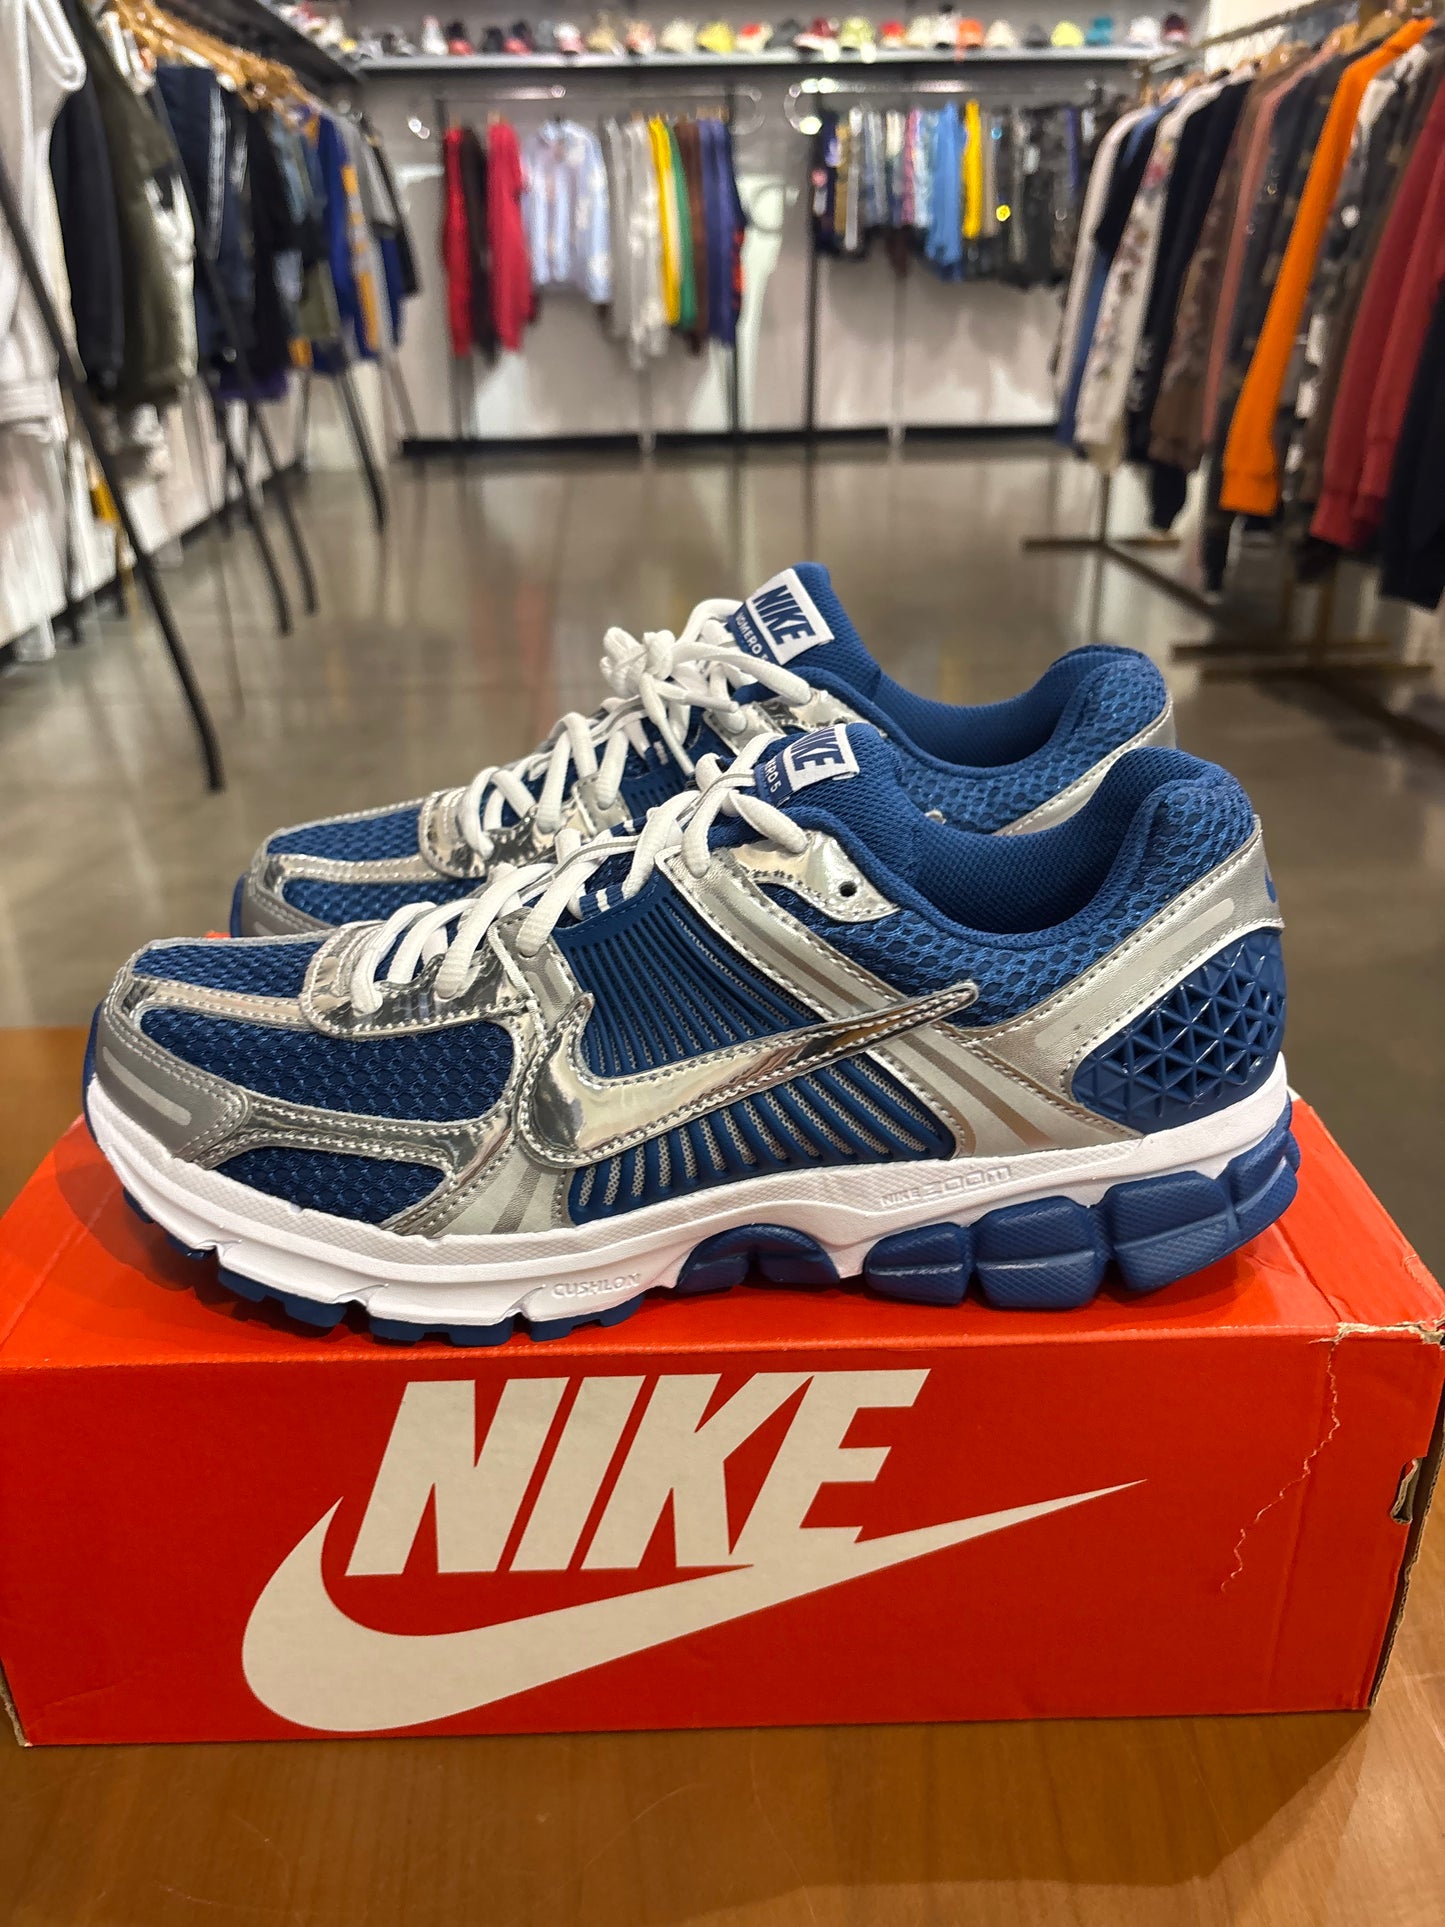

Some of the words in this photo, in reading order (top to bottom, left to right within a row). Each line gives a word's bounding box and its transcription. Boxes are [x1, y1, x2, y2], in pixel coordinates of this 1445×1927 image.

[752, 584, 816, 646] NIKE
[770, 780, 782, 793] 5
[880, 1187, 921, 1207] NIKE
[552, 1272, 641, 1299] CUSHLON
[345, 1368, 931, 1576] NIKE
